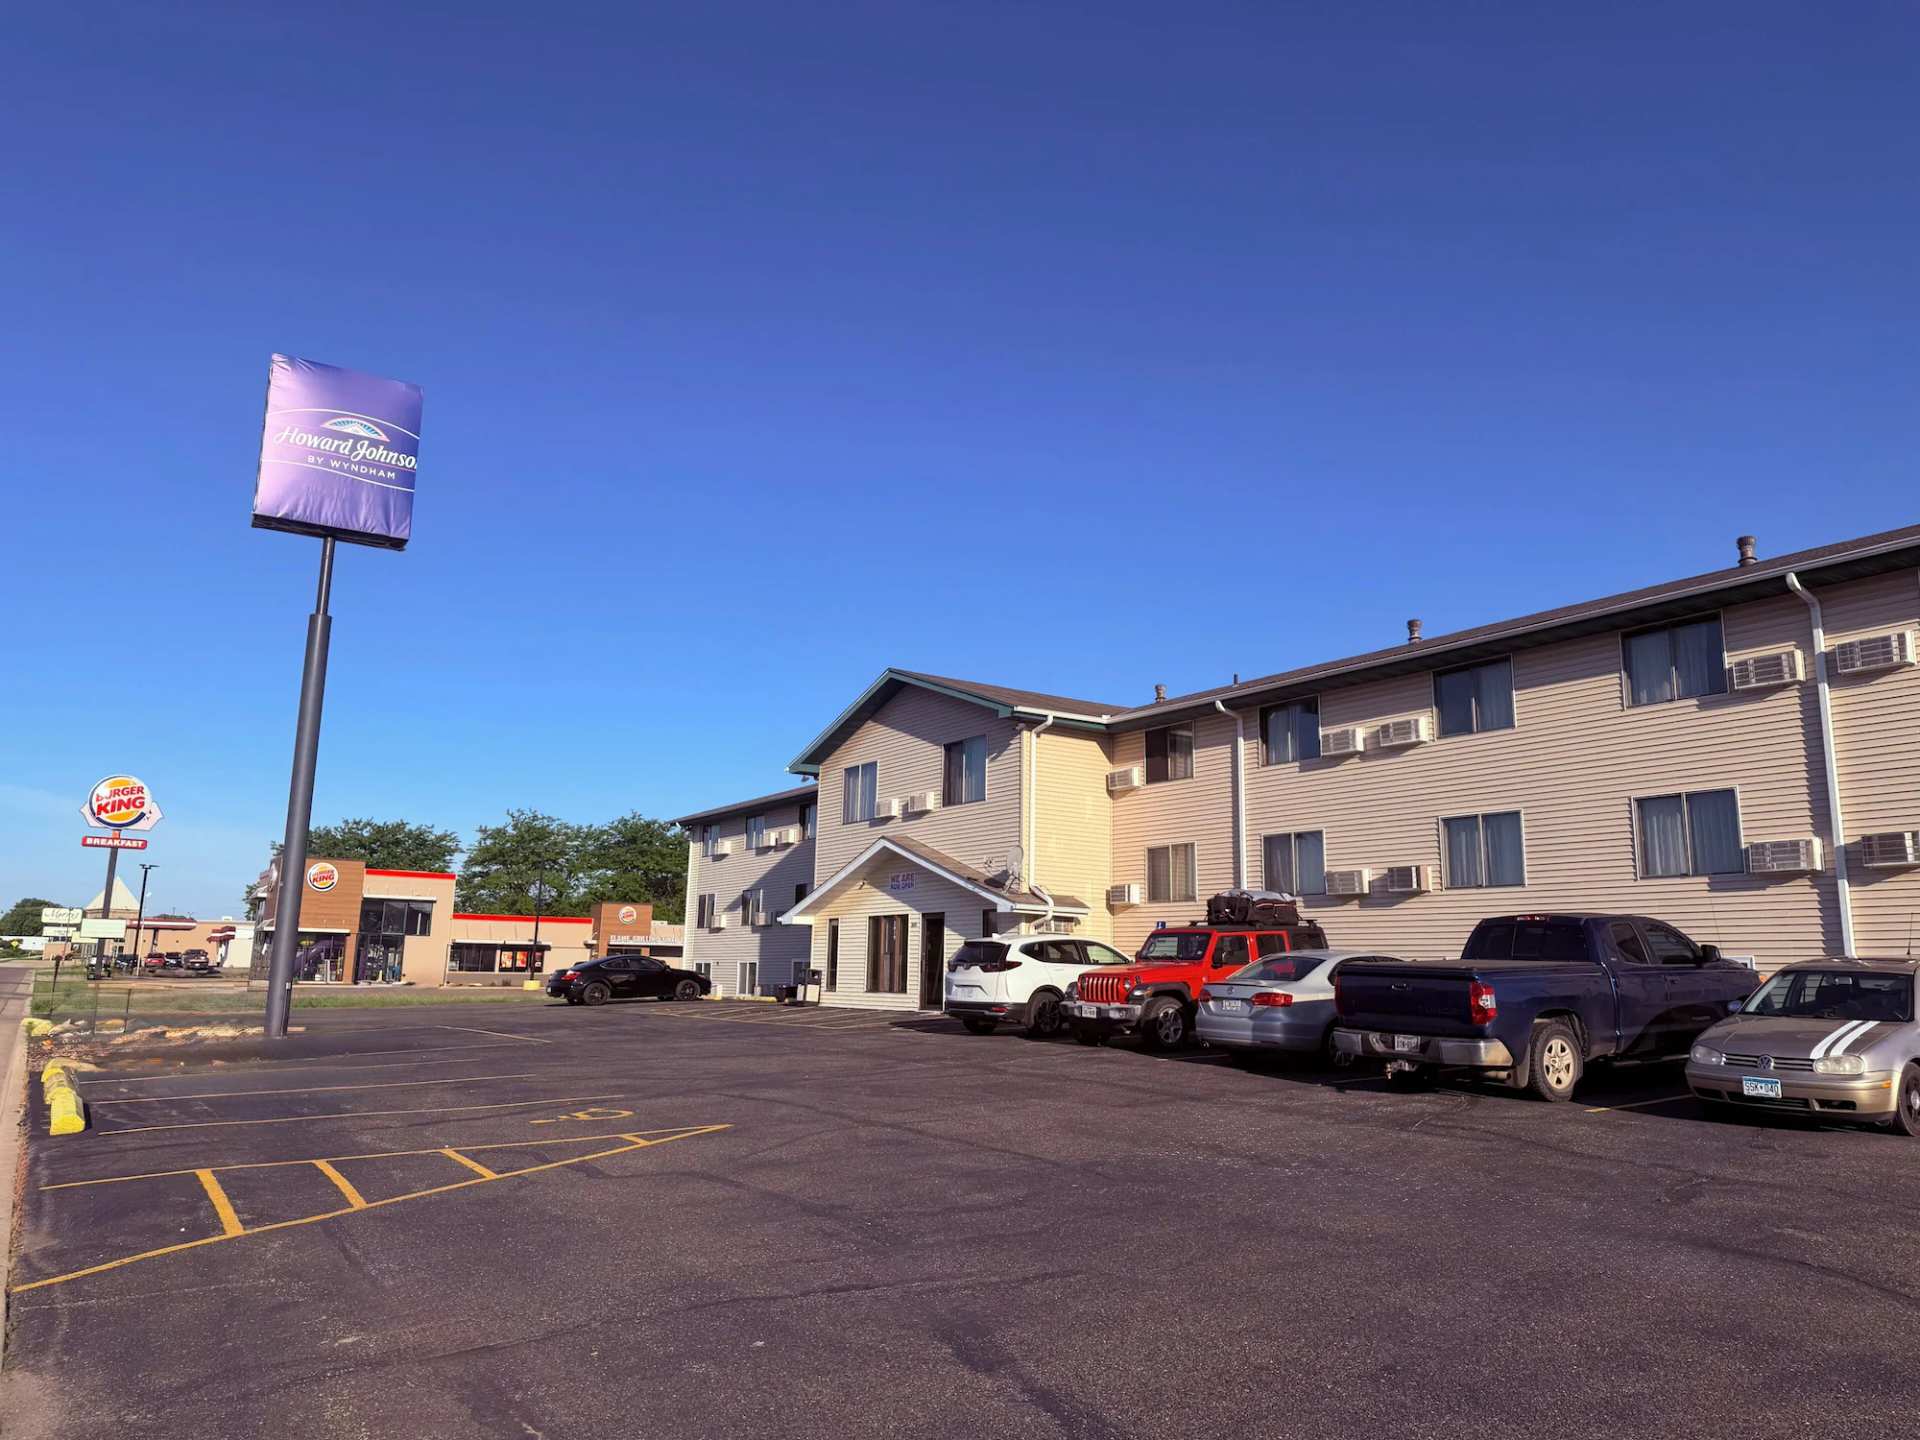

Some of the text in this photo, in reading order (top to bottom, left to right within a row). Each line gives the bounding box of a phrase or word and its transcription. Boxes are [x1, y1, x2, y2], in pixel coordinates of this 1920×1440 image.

[273, 426, 417, 469] Howard Johnso
[307, 454, 396, 479] BY WYNDHAM
[96, 796, 146, 816] KING
[86, 837, 144, 848] BREAKFAST
[312, 874, 335, 883] KING
